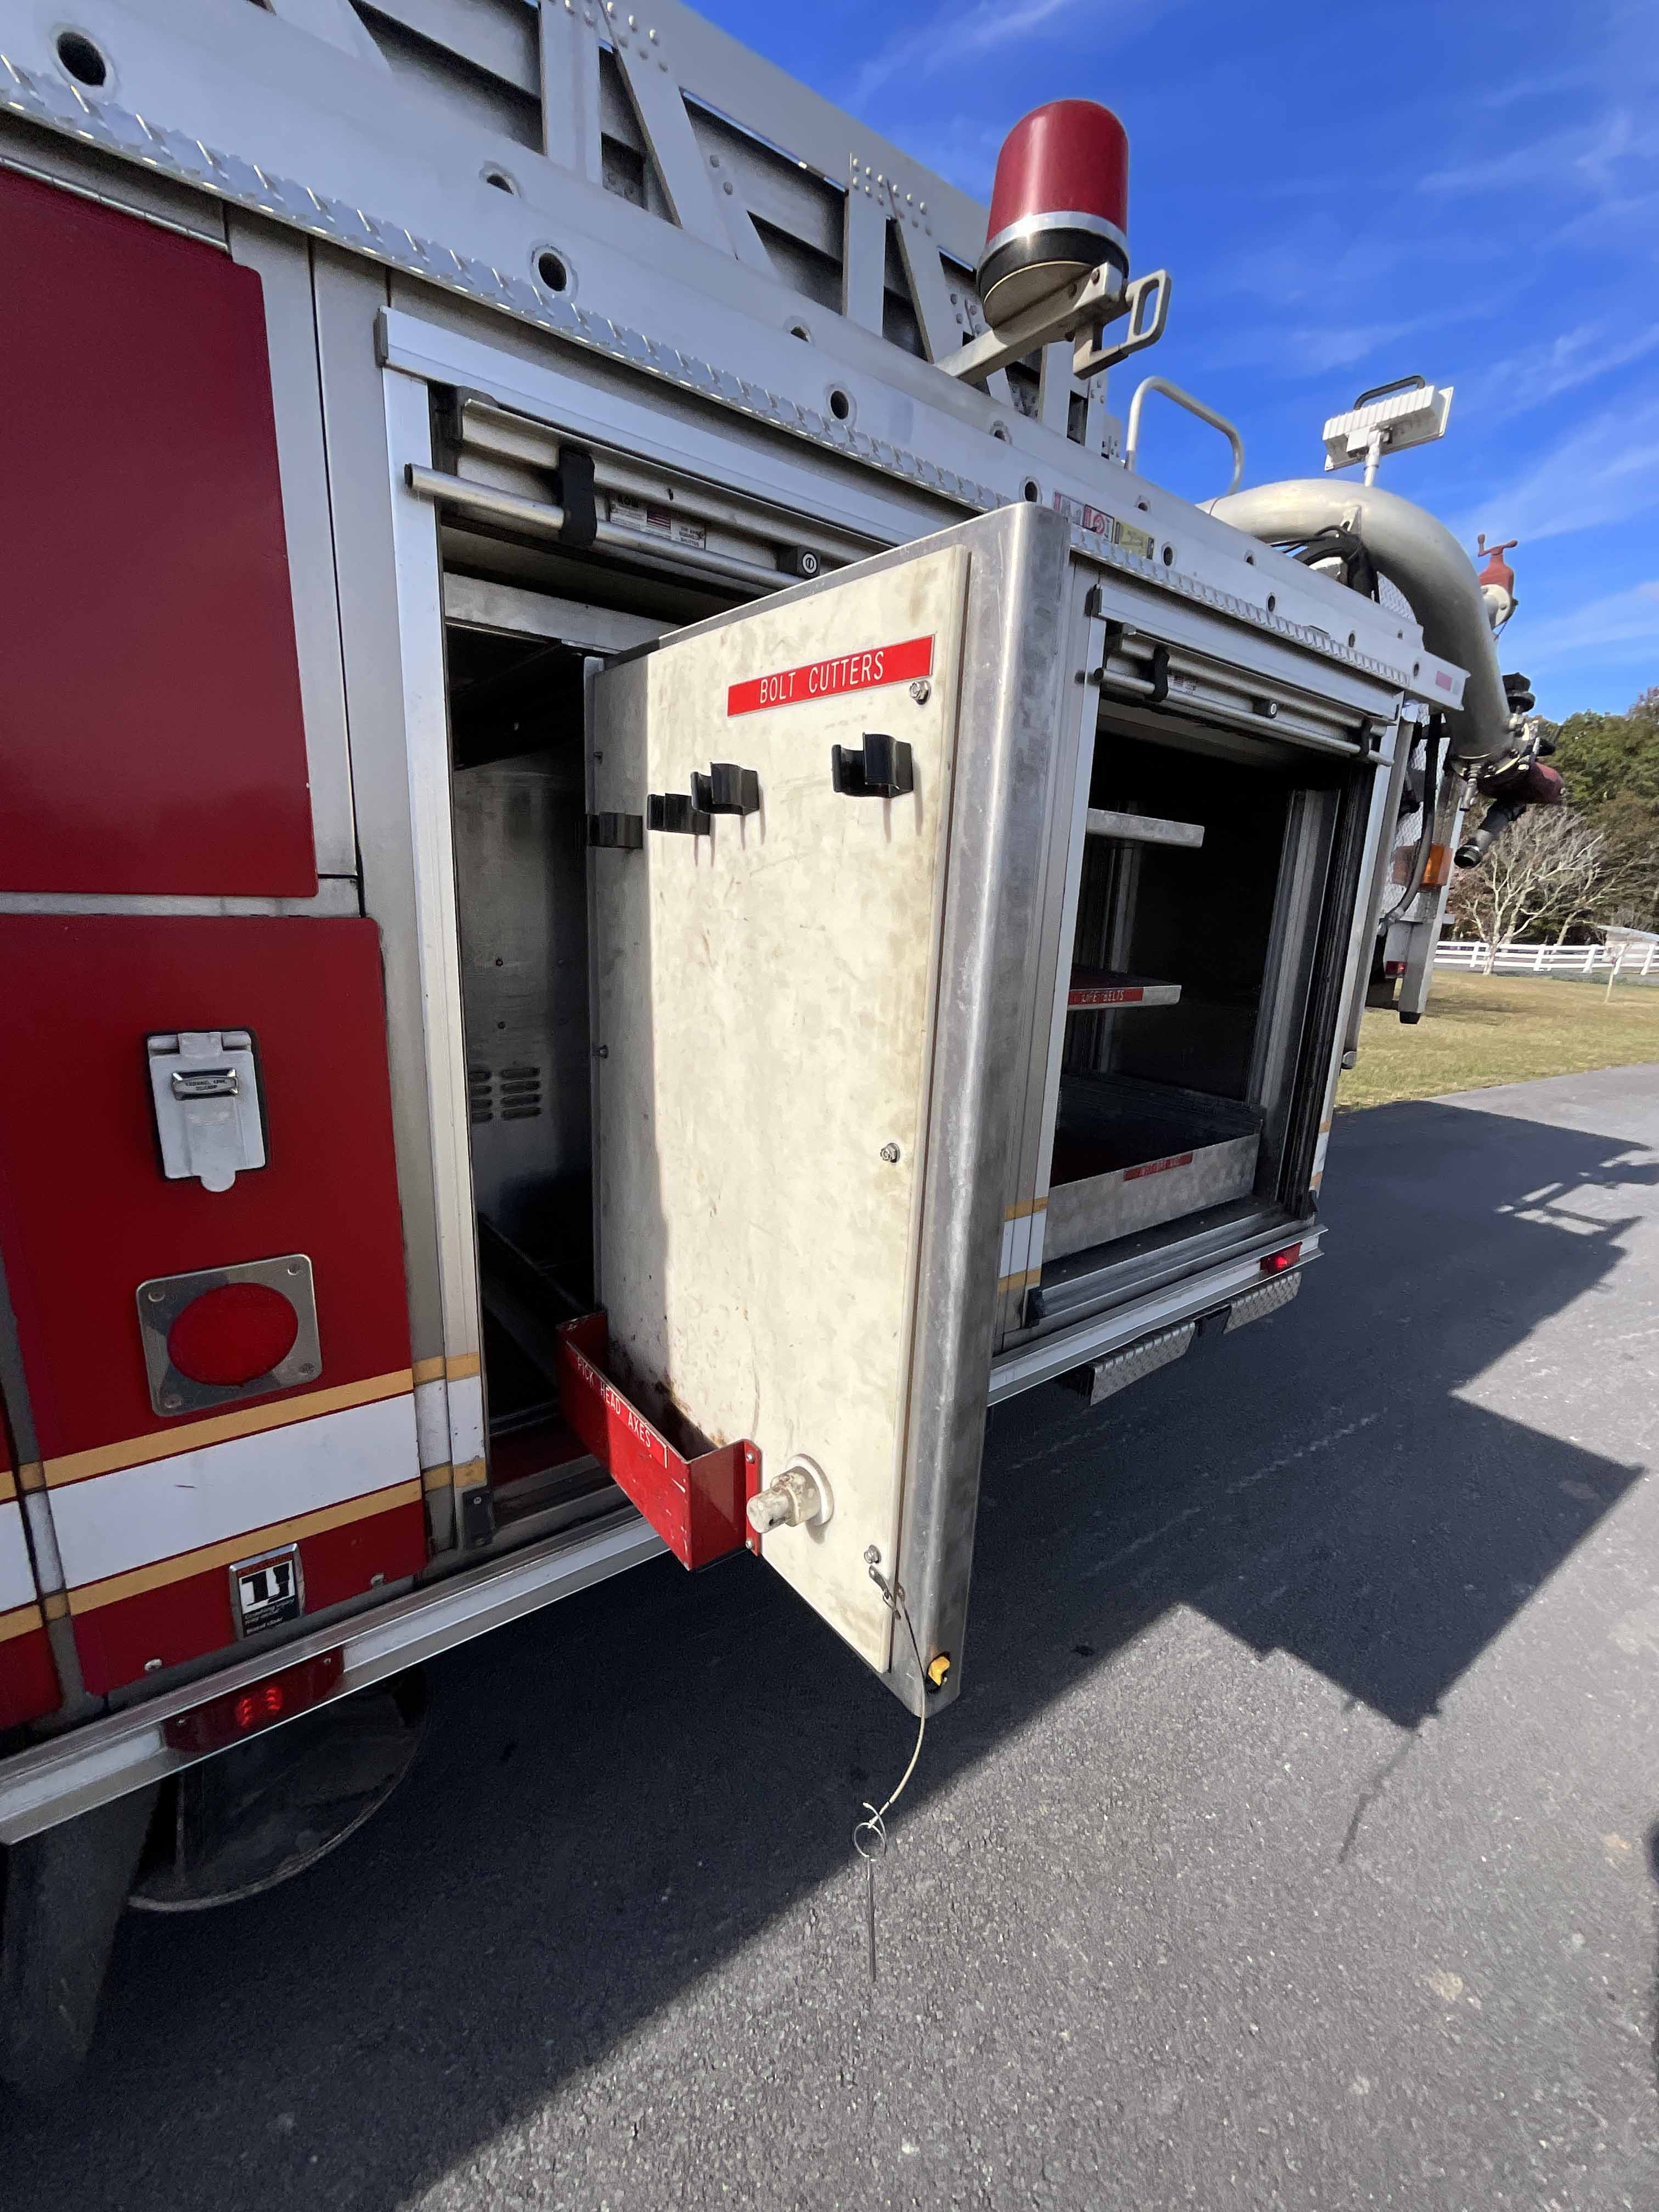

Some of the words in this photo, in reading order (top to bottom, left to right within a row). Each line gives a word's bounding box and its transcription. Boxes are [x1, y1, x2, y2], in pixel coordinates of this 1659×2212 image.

[759, 672, 795, 703] BOLT
[808, 651, 884, 693] CUTTERS
[577, 1356, 594, 1387] PICK
[600, 1381, 620, 1415] HEAD
[628, 1412, 651, 1448] AXES
